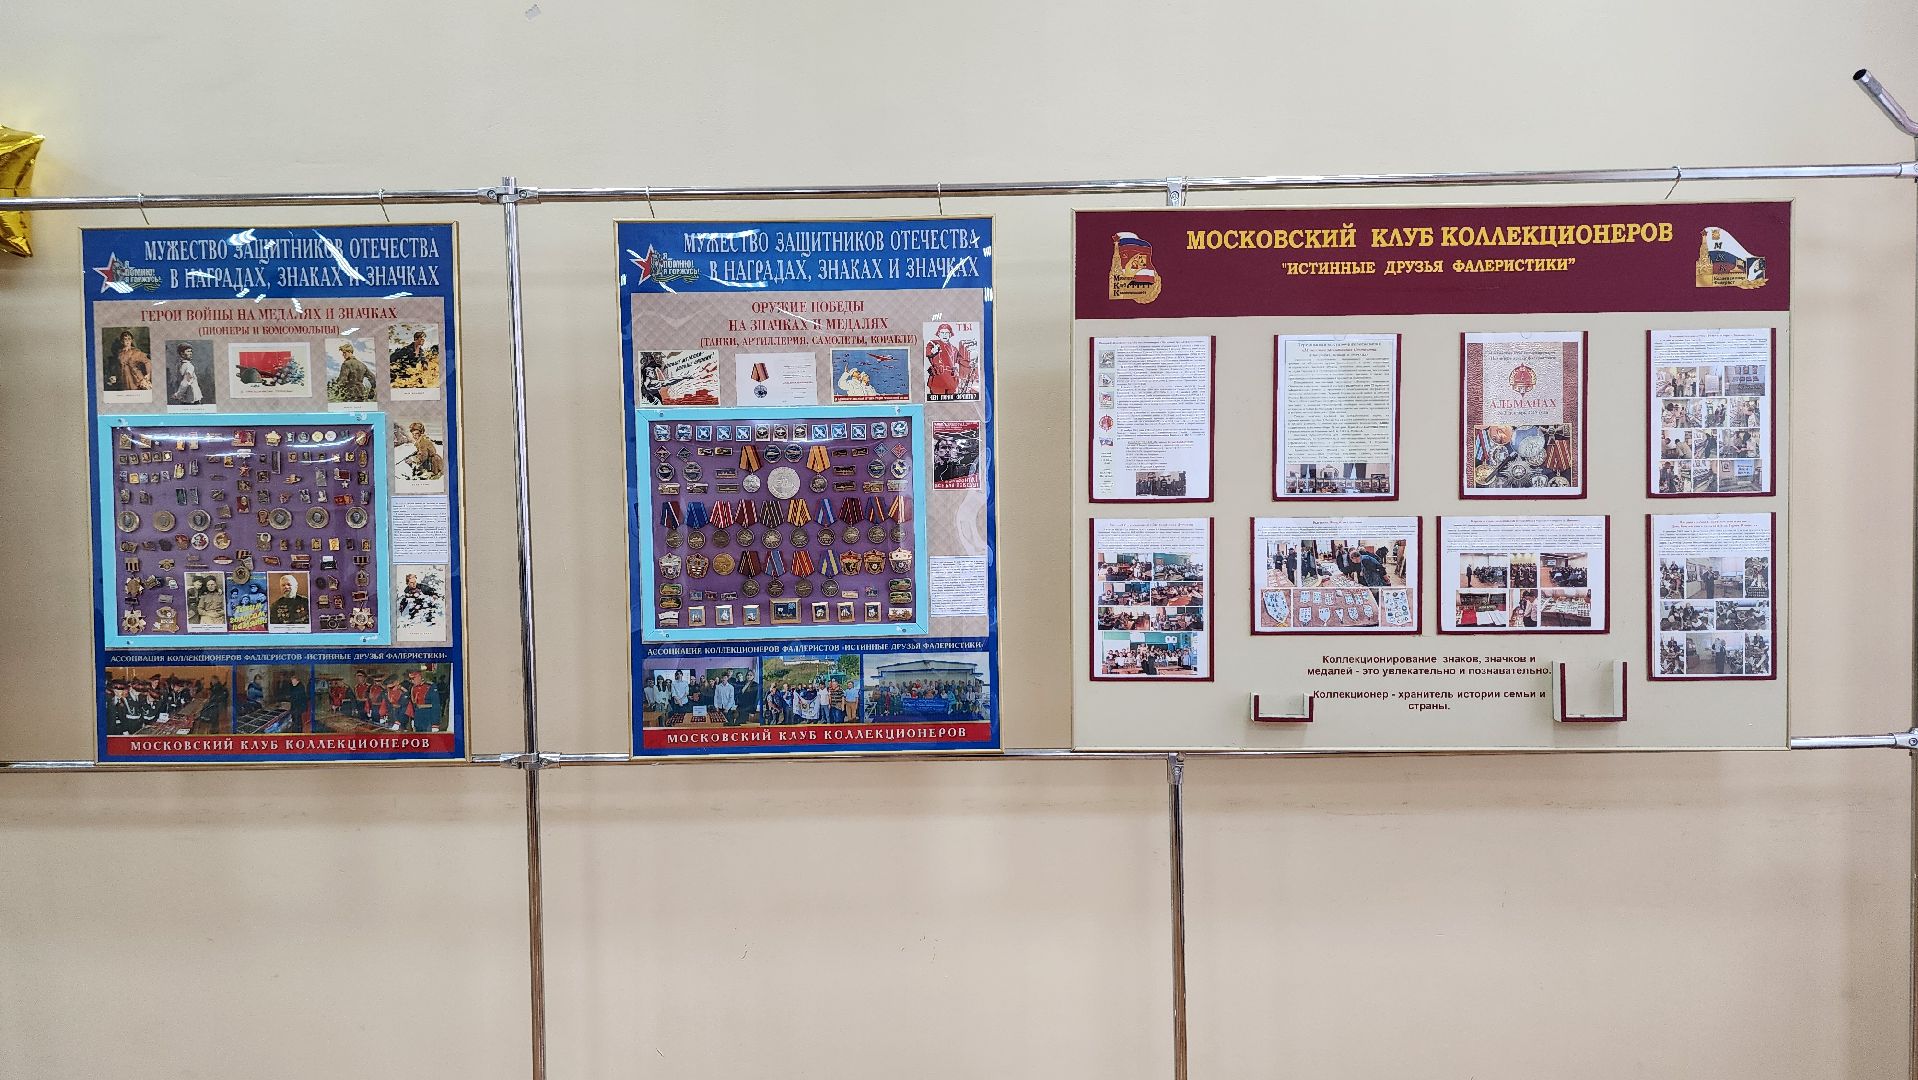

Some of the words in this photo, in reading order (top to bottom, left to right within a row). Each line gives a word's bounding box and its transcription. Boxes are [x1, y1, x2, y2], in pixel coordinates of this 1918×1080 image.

[684, 232, 769, 253] МУЖЕСТВО
[775, 230, 885, 257] ЗАЩИТНИКОВ
[890, 229, 980, 251] ОТЕЧЕСТВА
[1186, 223, 1356, 250] МОСКОВСКИЙ
[1371, 227, 1434, 248] КЛУБ
[1441, 222, 1673, 247] КОЛЛЕКЦИОНЕРОВ
[144, 239, 228, 261] МУЖЕСТВО
[234, 237, 344, 264] ЗАЩИТНИКОВ
[350, 237, 439, 259] ОТЕЧЕСТВА
[710, 260, 719, 281] В
[724, 259, 811, 283] НАГРАДАХ,
[818, 258, 884, 280] ЗНАКАХ
[889, 258, 899, 279] И
[905, 256, 980, 279] ЗНАЧКАХ
[1384, 260, 1443, 275] ДРУЗЬЯ
[170, 268, 179, 289] В
[185, 267, 270, 291] НАГРАДАХ,
[277, 267, 341, 287] ЗНАКАХ
[366, 266, 439, 287] ЗНАЧКАХ
[751, 301, 808, 313] ОРУЖИЕ
[811, 300, 864, 314] ПОБЕДЫ
[141, 309, 181, 321] ГЕРОИ
[187, 307, 233, 321] ВОЙНЫ
[239, 309, 256, 320] НА
[260, 308, 321, 322] МЕДАЛЯХ
[326, 308, 334, 320] И
[338, 307, 398, 319] ЗНАЧКАХ
[198, 326, 249, 336] (ПИОНЕРЫ
[253, 326, 259, 335] И
[262, 324, 340, 336] КОМСОМОЛЬЦЫ)
[729, 319, 747, 331] НА
[750, 318, 807, 331] ЗНАЧКАХ
[814, 319, 821, 329] И
[826, 317, 889, 331] МЕДАЛЯХ
[700, 336, 740, 348] (ТАНКИ,
[871, 334, 918, 346] КОРАБЛИ)
[1489, 398, 1556, 409] АЛЬМАНАХ
[705, 645, 780, 654] КОЛЛЕКЦИОНЕРОВ
[167, 654, 241, 662] КОЛЛЕКЦИОНЕРОВ
[1322, 655, 1437, 666] Коллекционирование
[1442, 655, 1482, 665] знаков,
[1485, 655, 1527, 664] значков
[1529, 656, 1536, 664] и
[1307, 666, 1353, 677] медалей
[1362, 668, 1380, 676] это
[1382, 667, 1456, 677] увлекательно
[1468, 667, 1552, 676] познавательно.
[1313, 690, 1389, 701] Коллекционер
[1398, 691, 1453, 701] хранитель
[1457, 691, 1501, 701] истории
[1503, 691, 1537, 699] семьи
[1539, 691, 1546, 699] и
[1408, 703, 1451, 712] страны.
[667, 729, 772, 743] МОСКОВСКИЙ
[779, 730, 818, 741] КЛУБ
[824, 727, 966, 741] КОЛЛЕКЦИОНЕРОВ
[130, 738, 234, 751] МОСКОВСКИЙ
[240, 740, 279, 750] КЛУБ
[285, 738, 431, 751] КОЛЛЕКЦИОНЕРОВ
